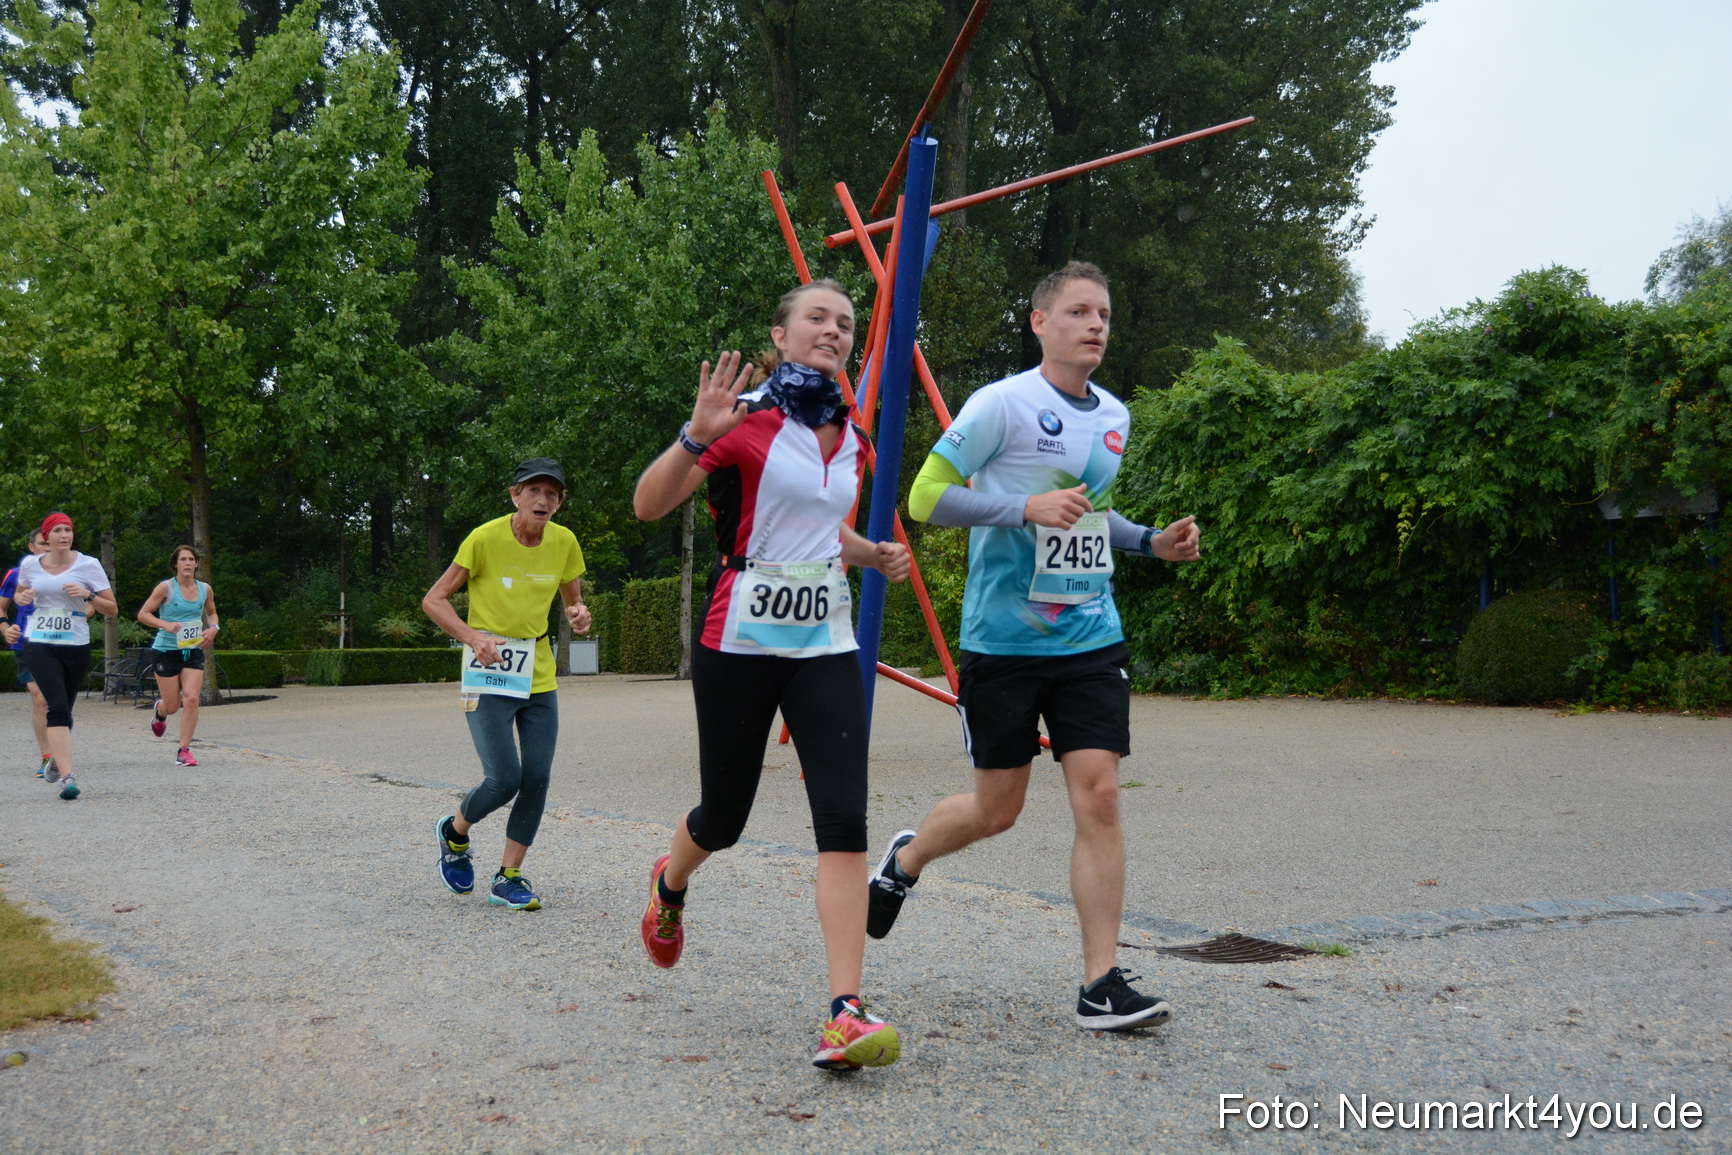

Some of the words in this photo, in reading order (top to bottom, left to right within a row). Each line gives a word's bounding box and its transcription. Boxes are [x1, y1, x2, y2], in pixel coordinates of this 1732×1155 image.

[1036, 446, 1066, 456] Neumarkt
[1037, 438, 1066, 450] PARTL
[1046, 535, 1107, 569] 2452
[1065, 578, 1090, 592] Timo
[750, 583, 829, 622] 3006
[36, 616, 72, 630] 2408
[470, 648, 529, 673] 287
[485, 675, 507, 687] Gabi
